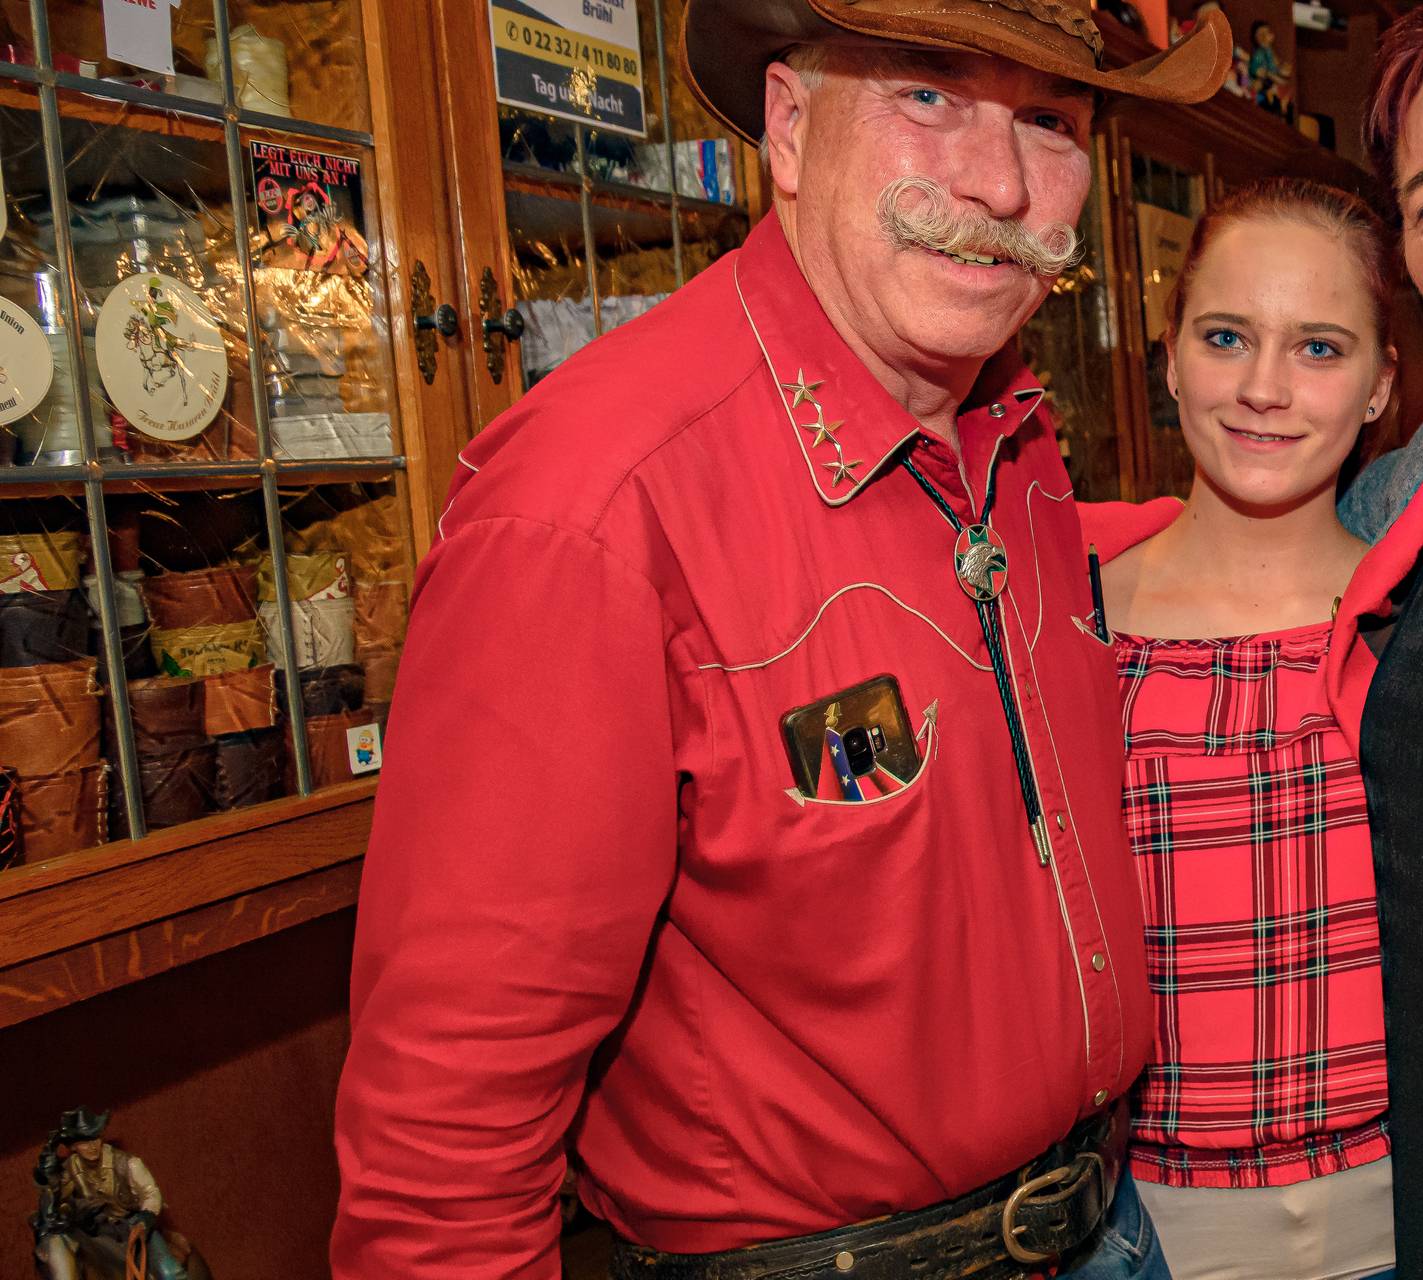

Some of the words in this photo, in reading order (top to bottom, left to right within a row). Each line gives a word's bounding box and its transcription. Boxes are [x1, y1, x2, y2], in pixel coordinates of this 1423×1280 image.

[583, 0, 612, 24] Brühl
[523, 27, 531, 45] 0
[535, 30, 551, 51] 22
[555, 36, 571, 58] 32
[582, 45, 590, 62] 4
[593, 48, 604, 66] 11
[532, 74, 557, 102] Tag
[253, 143, 285, 162] LEGT
[290, 150, 320, 167] EUCH
[325, 157, 359, 175] NICHT
[270, 162, 291, 177] MIT
[295, 165, 319, 181] UNS
